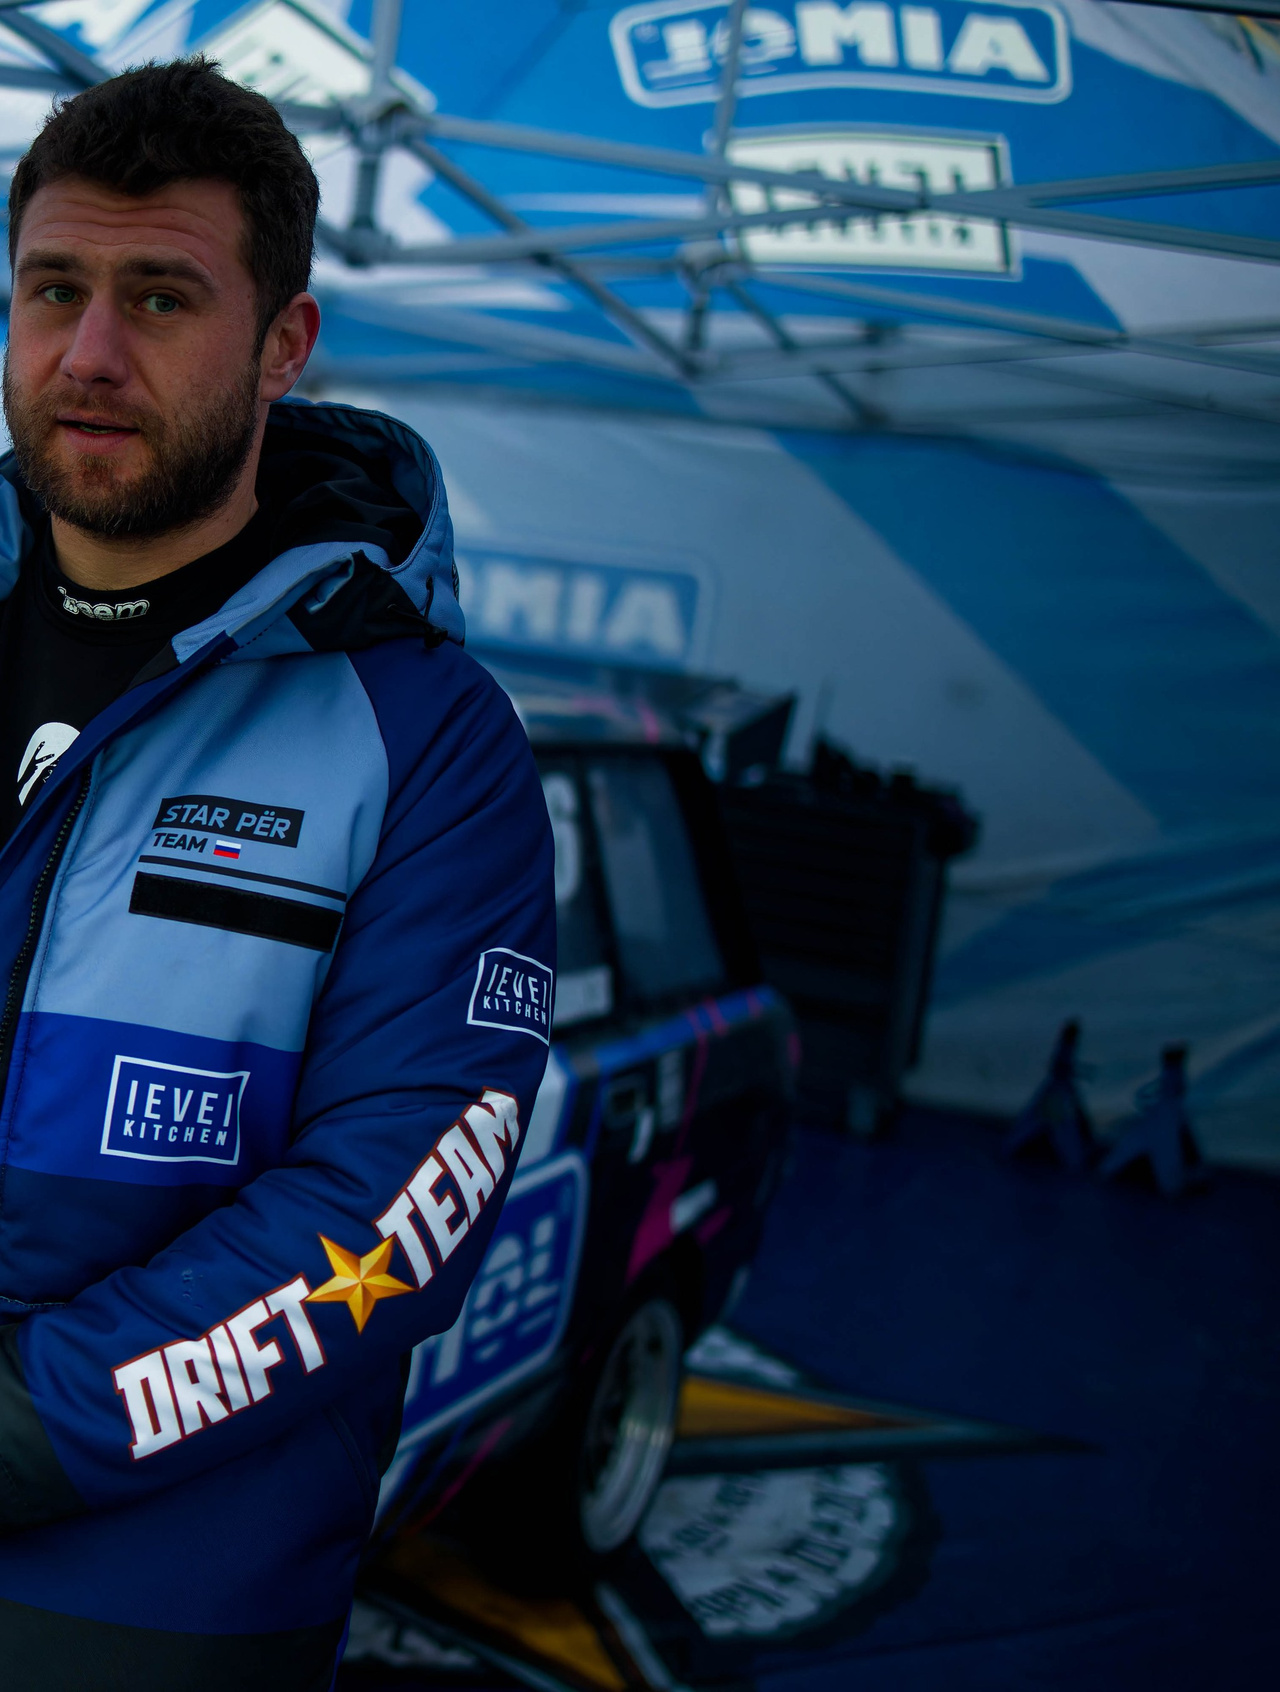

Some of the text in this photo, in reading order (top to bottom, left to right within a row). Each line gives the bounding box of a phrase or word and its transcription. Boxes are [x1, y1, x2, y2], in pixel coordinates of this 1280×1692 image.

[161, 803, 291, 840] STAR PËR
[153, 832, 208, 853] TEAM
[482, 994, 547, 1026] KITCHEN
[122, 1118, 228, 1147] KITCHEN
[111, 1086, 521, 1463] DRIFT TEAM
